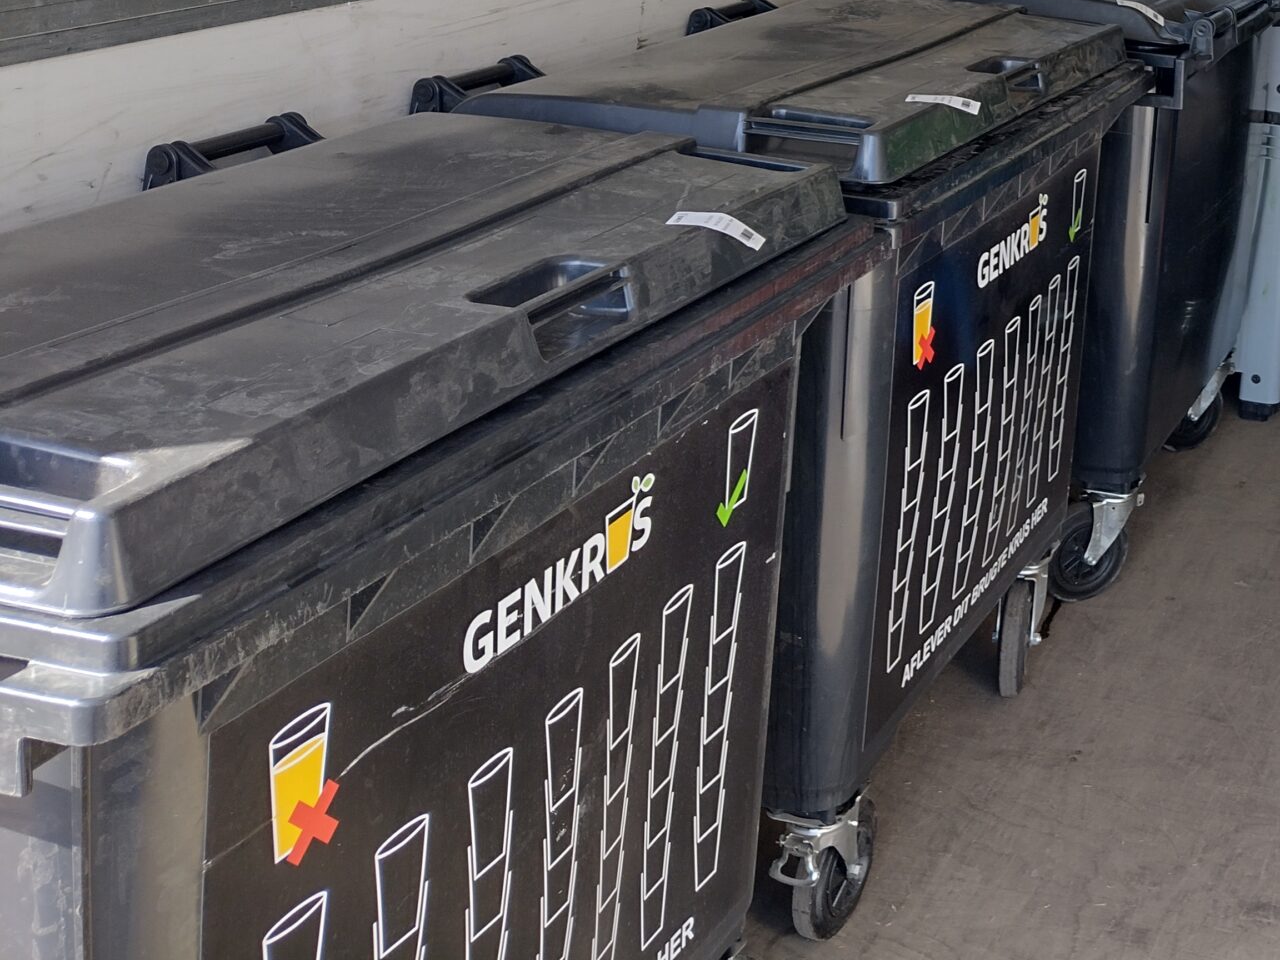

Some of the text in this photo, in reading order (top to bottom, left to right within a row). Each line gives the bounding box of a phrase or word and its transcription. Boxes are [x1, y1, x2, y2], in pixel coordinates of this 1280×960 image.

[901, 497, 1048, 688] AFLEVER DIT BRUGTE KRUS HER
